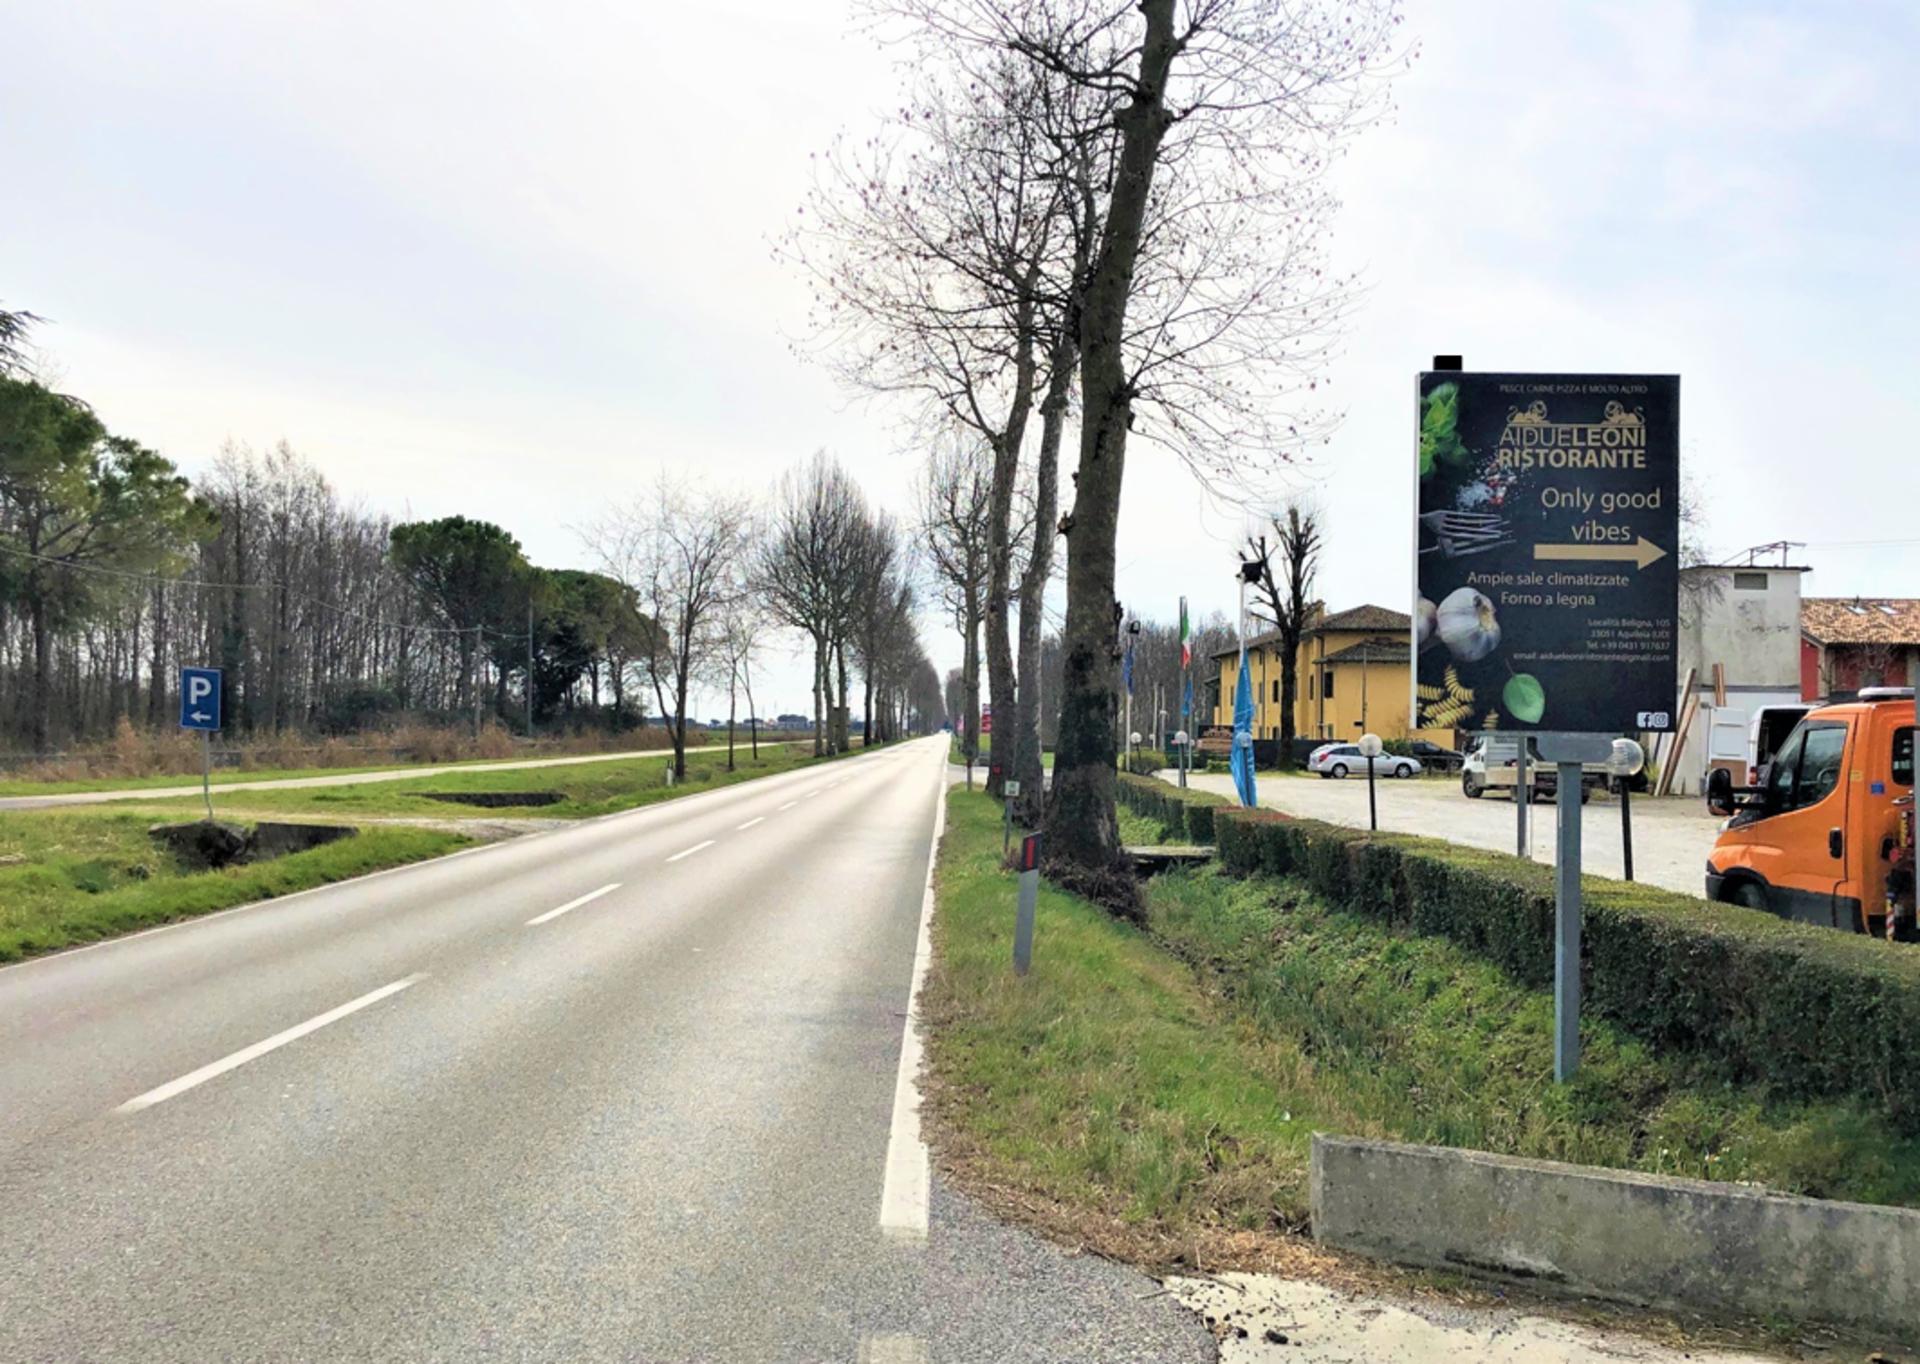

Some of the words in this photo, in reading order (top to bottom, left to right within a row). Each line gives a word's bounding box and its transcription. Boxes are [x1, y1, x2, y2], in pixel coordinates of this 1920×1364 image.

[1499, 385, 1525, 393] PESCE
[1526, 385, 1555, 393] CARNE
[1556, 385, 1580, 393] PIZZA
[1499, 449, 1646, 468] RISTORANTE
[1541, 488, 1594, 512] Only
[1601, 488, 1661, 512] good
[1572, 520, 1631, 541] vibes
[1467, 572, 1513, 587] Ampie
[1517, 572, 1543, 585] sale
[1547, 572, 1629, 586] climatizzate
[1501, 593, 1542, 605] Forno
[1545, 596, 1553, 605] a
[1556, 593, 1595, 609] legna
[190, 676, 212, 705] P
